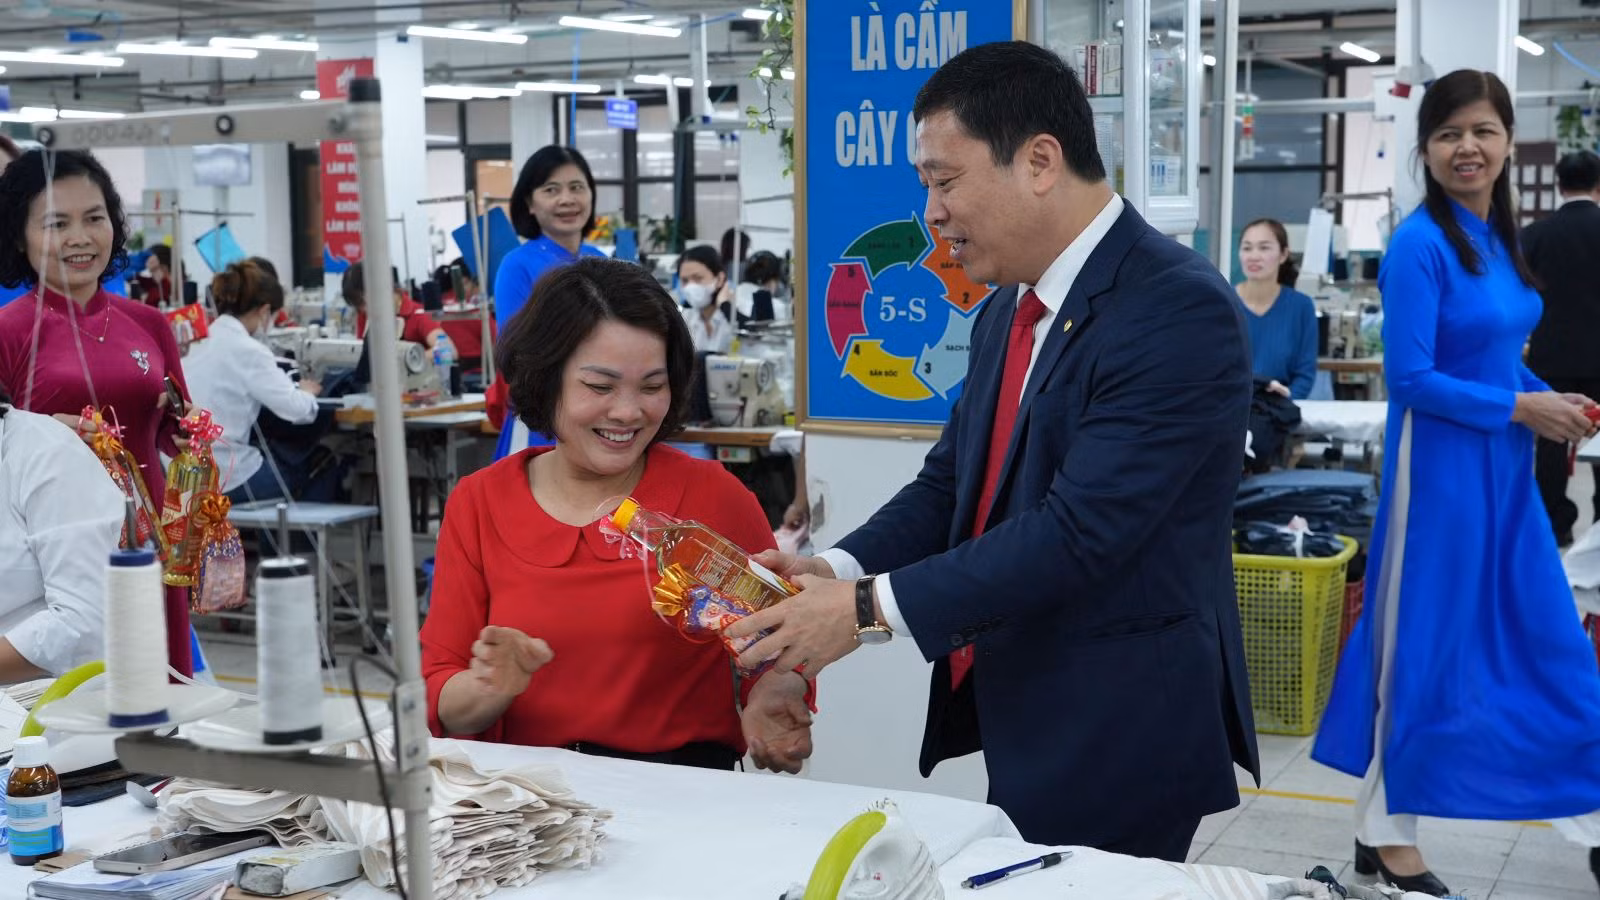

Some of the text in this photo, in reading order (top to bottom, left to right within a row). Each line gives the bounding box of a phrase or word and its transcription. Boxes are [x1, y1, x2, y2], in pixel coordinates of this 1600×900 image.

[851, 0, 967, 71] LÀ CẦM
[835, 99, 898, 168] CÂY
[962, 292, 970, 304] 2
[879, 296, 926, 322] 5-S
[853, 344, 861, 355] 4
[924, 362, 932, 374] 3
